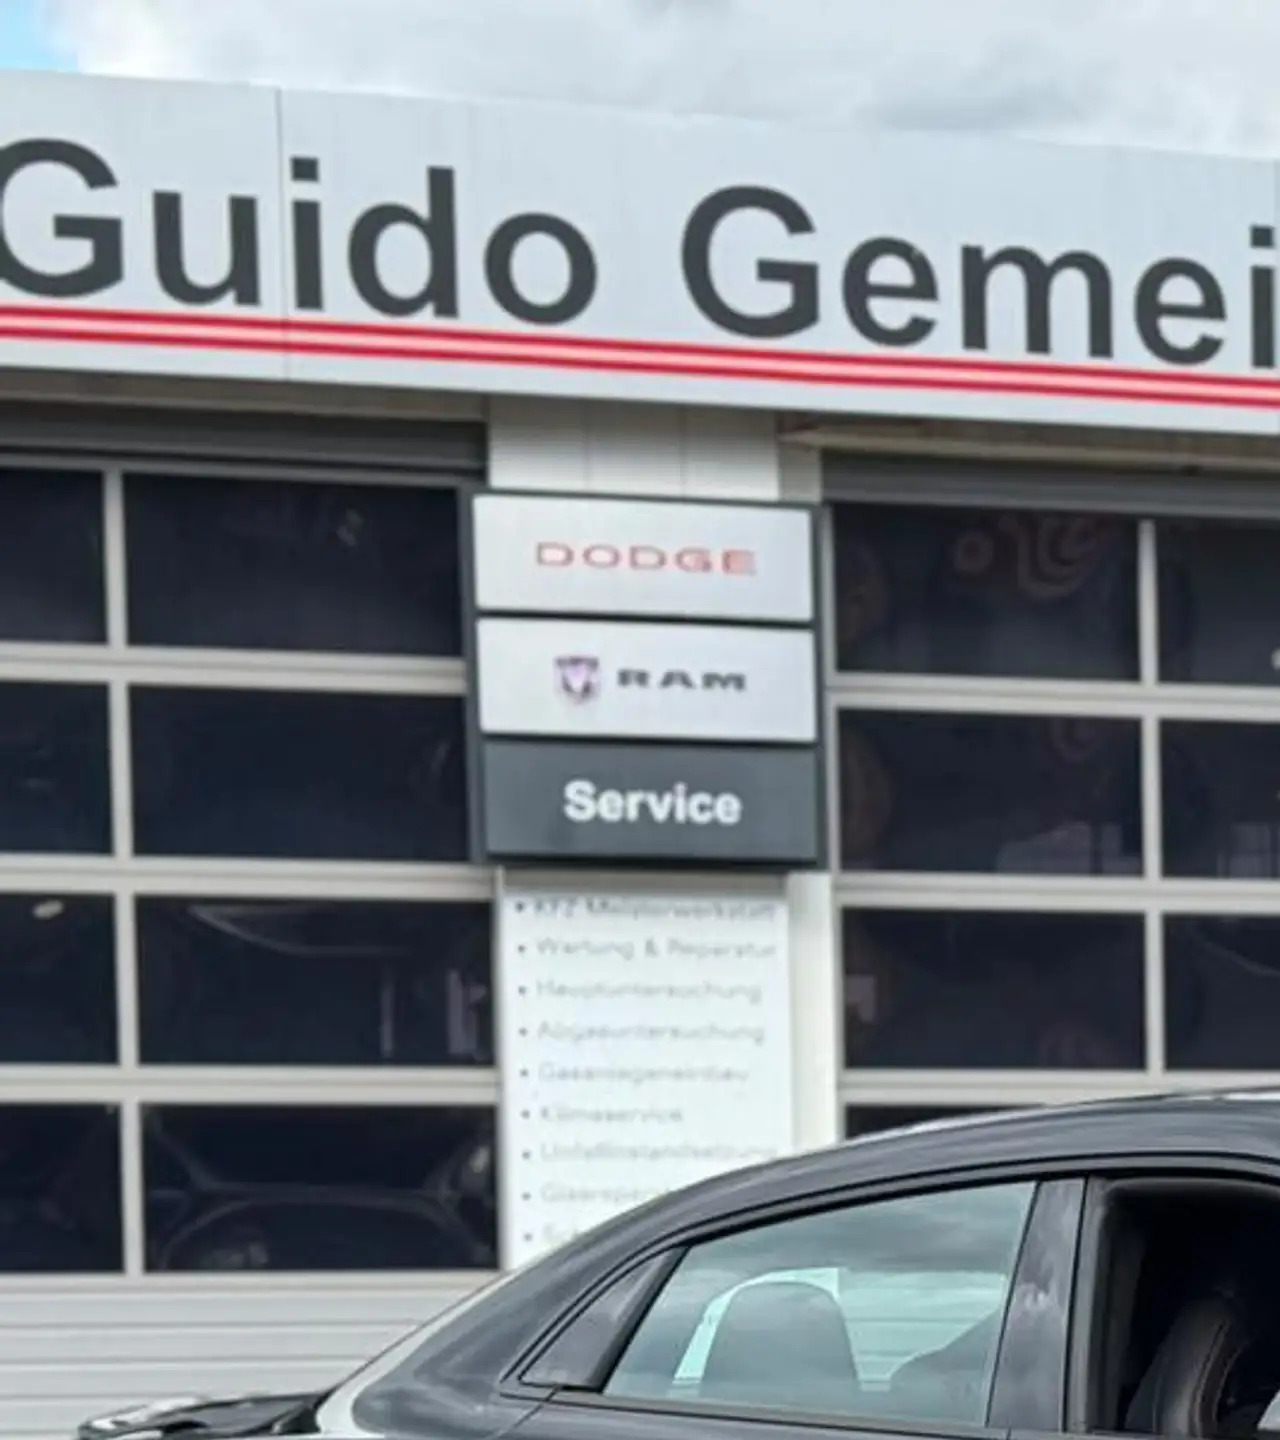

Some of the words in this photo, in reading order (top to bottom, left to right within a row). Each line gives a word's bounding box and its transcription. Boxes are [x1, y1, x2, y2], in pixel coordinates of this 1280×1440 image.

[0, 139, 597, 325] Guido
[535, 541, 757, 575] DODGE
[617, 668, 747, 692] RAM
[563, 781, 743, 824] Service
